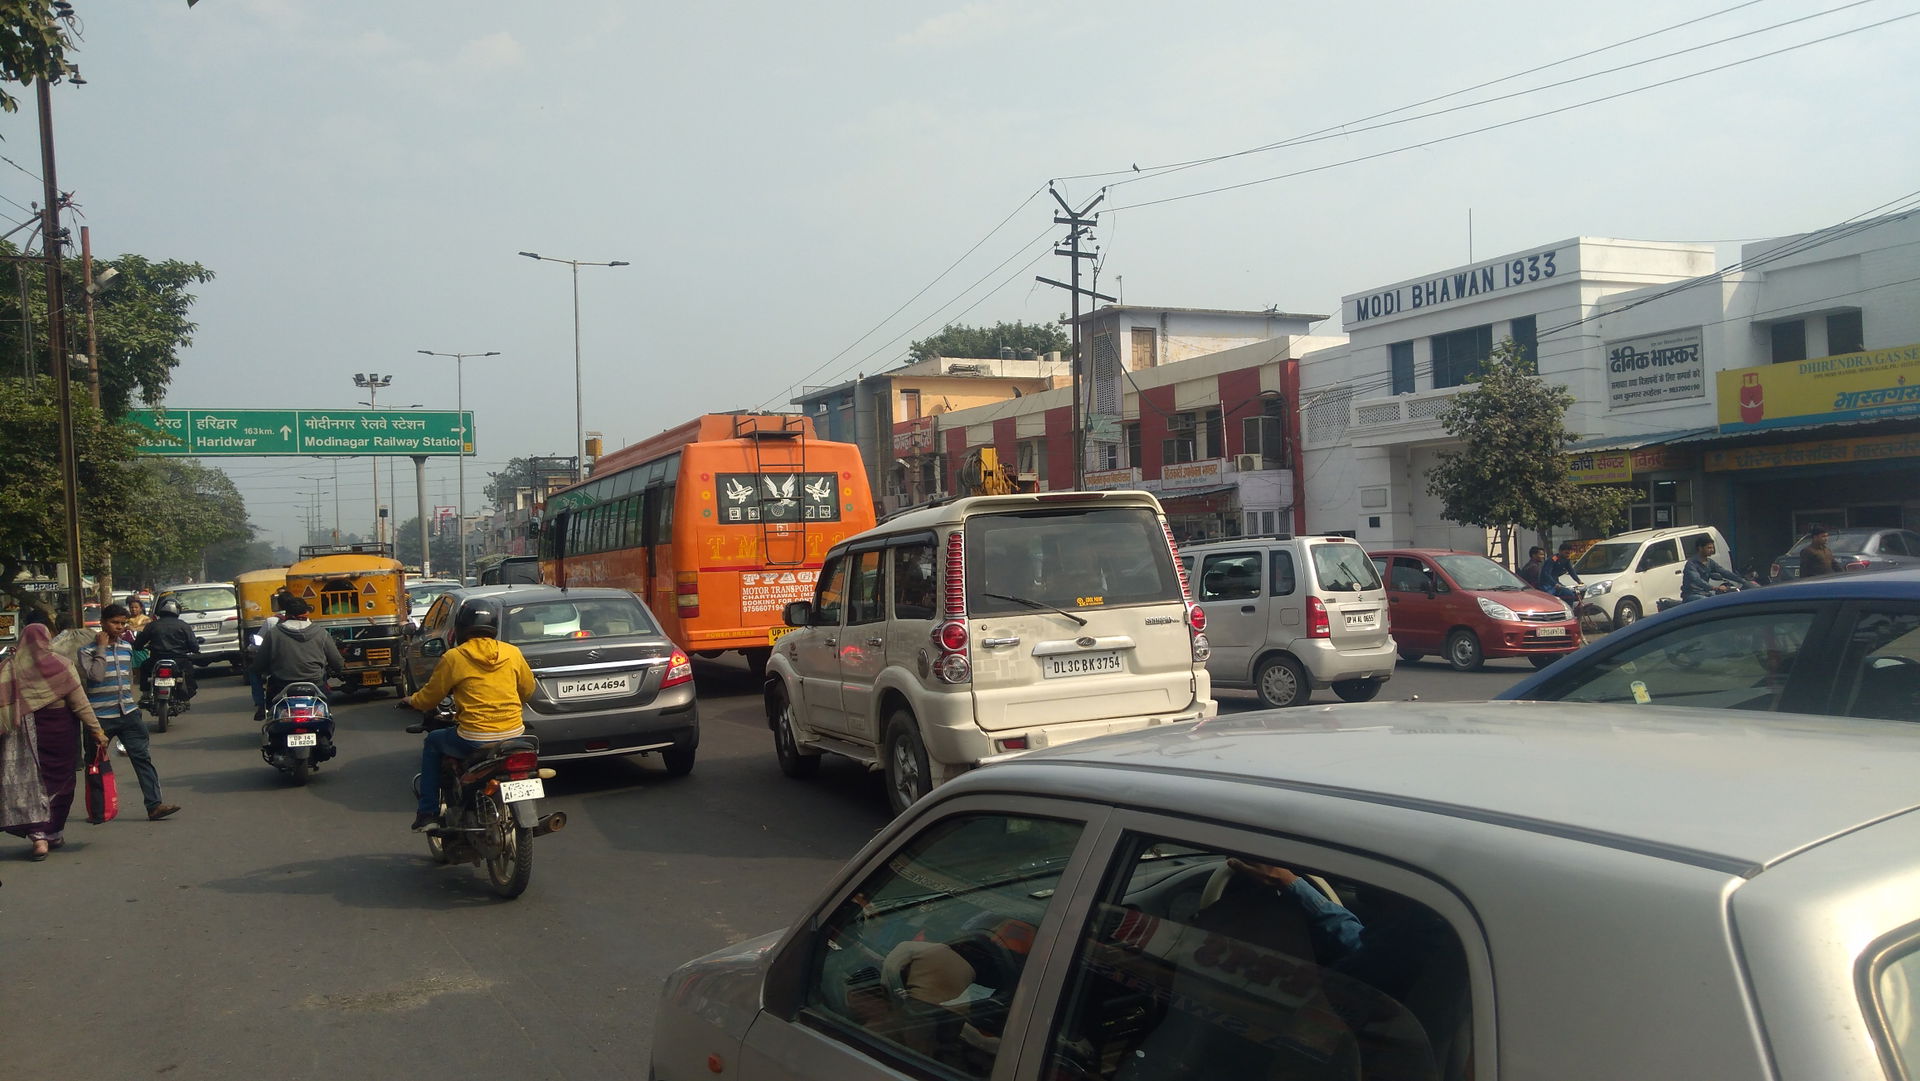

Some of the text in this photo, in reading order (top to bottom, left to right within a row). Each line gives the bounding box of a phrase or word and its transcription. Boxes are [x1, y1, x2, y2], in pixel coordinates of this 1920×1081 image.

[1357, 251, 1556, 321] MODI BHAWAN 1933
[1609, 343, 1699, 373] दैनिक भास्कर
[1799, 354, 1872, 375] DHIRENDRA
[1875, 350, 1902, 365] GAS
[196, 415, 238, 430] हरिद्वार
[304, 416, 426, 430] मोदीनगर रेलवे स्टेशन
[197, 437, 257, 447] Haridwar
[305, 437, 369, 449] Modinagar
[374, 437, 419, 449] Railway
[743, 585, 813, 596] MOTOR TRANSPORT
[562, 685, 574, 693] UP
